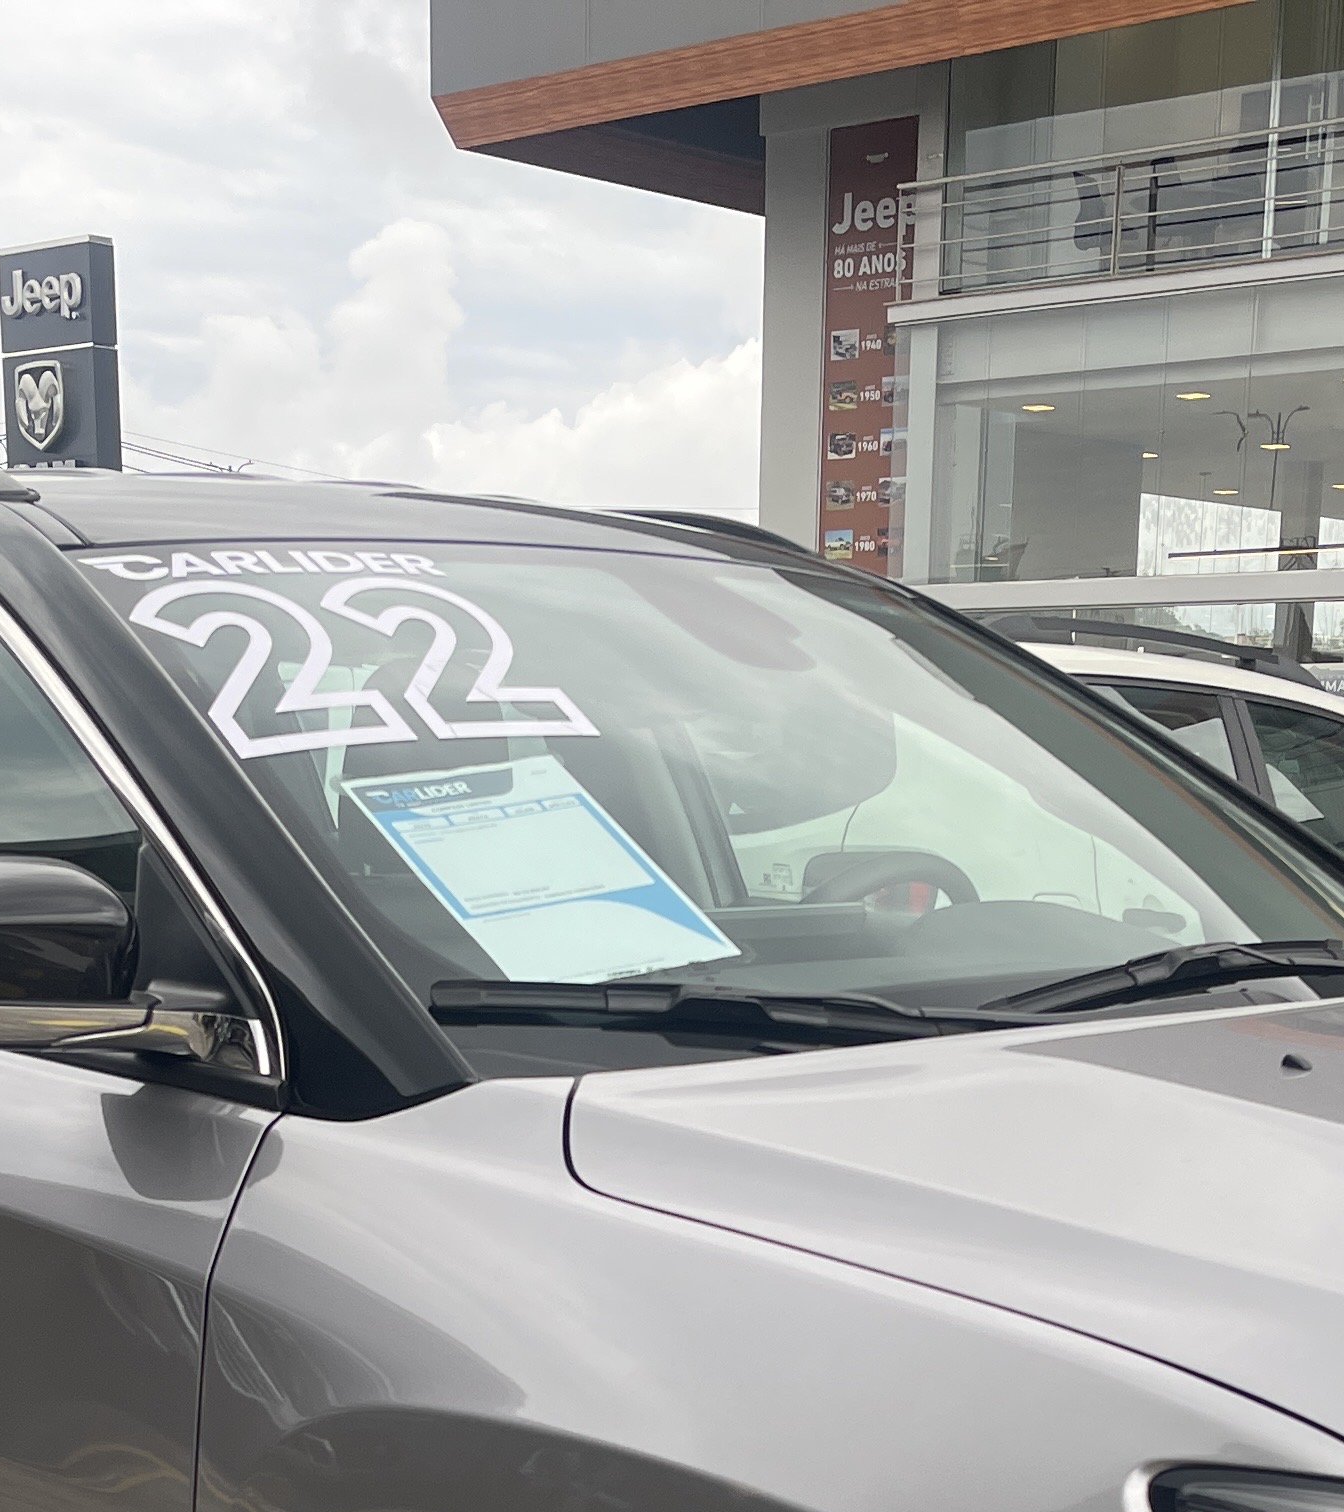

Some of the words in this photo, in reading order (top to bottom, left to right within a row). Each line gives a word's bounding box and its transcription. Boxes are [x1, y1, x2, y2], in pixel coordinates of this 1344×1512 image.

[832, 192, 916, 235] Jeep
[866, 241, 877, 251] DE
[834, 257, 854, 278] 80
[858, 252, 906, 276] ANOS
[856, 280, 867, 292] NA
[1, 269, 82, 319] Jeep
[861, 339, 882, 350] 1940
[860, 390, 881, 401] 1950
[858, 441, 878, 452] 1960
[856, 491, 877, 502] 1970
[855, 540, 875, 552] 1980
[78, 550, 447, 581] CARLIDER
[130, 577, 601, 759] 22
[365, 781, 472, 804] CARLIDER
